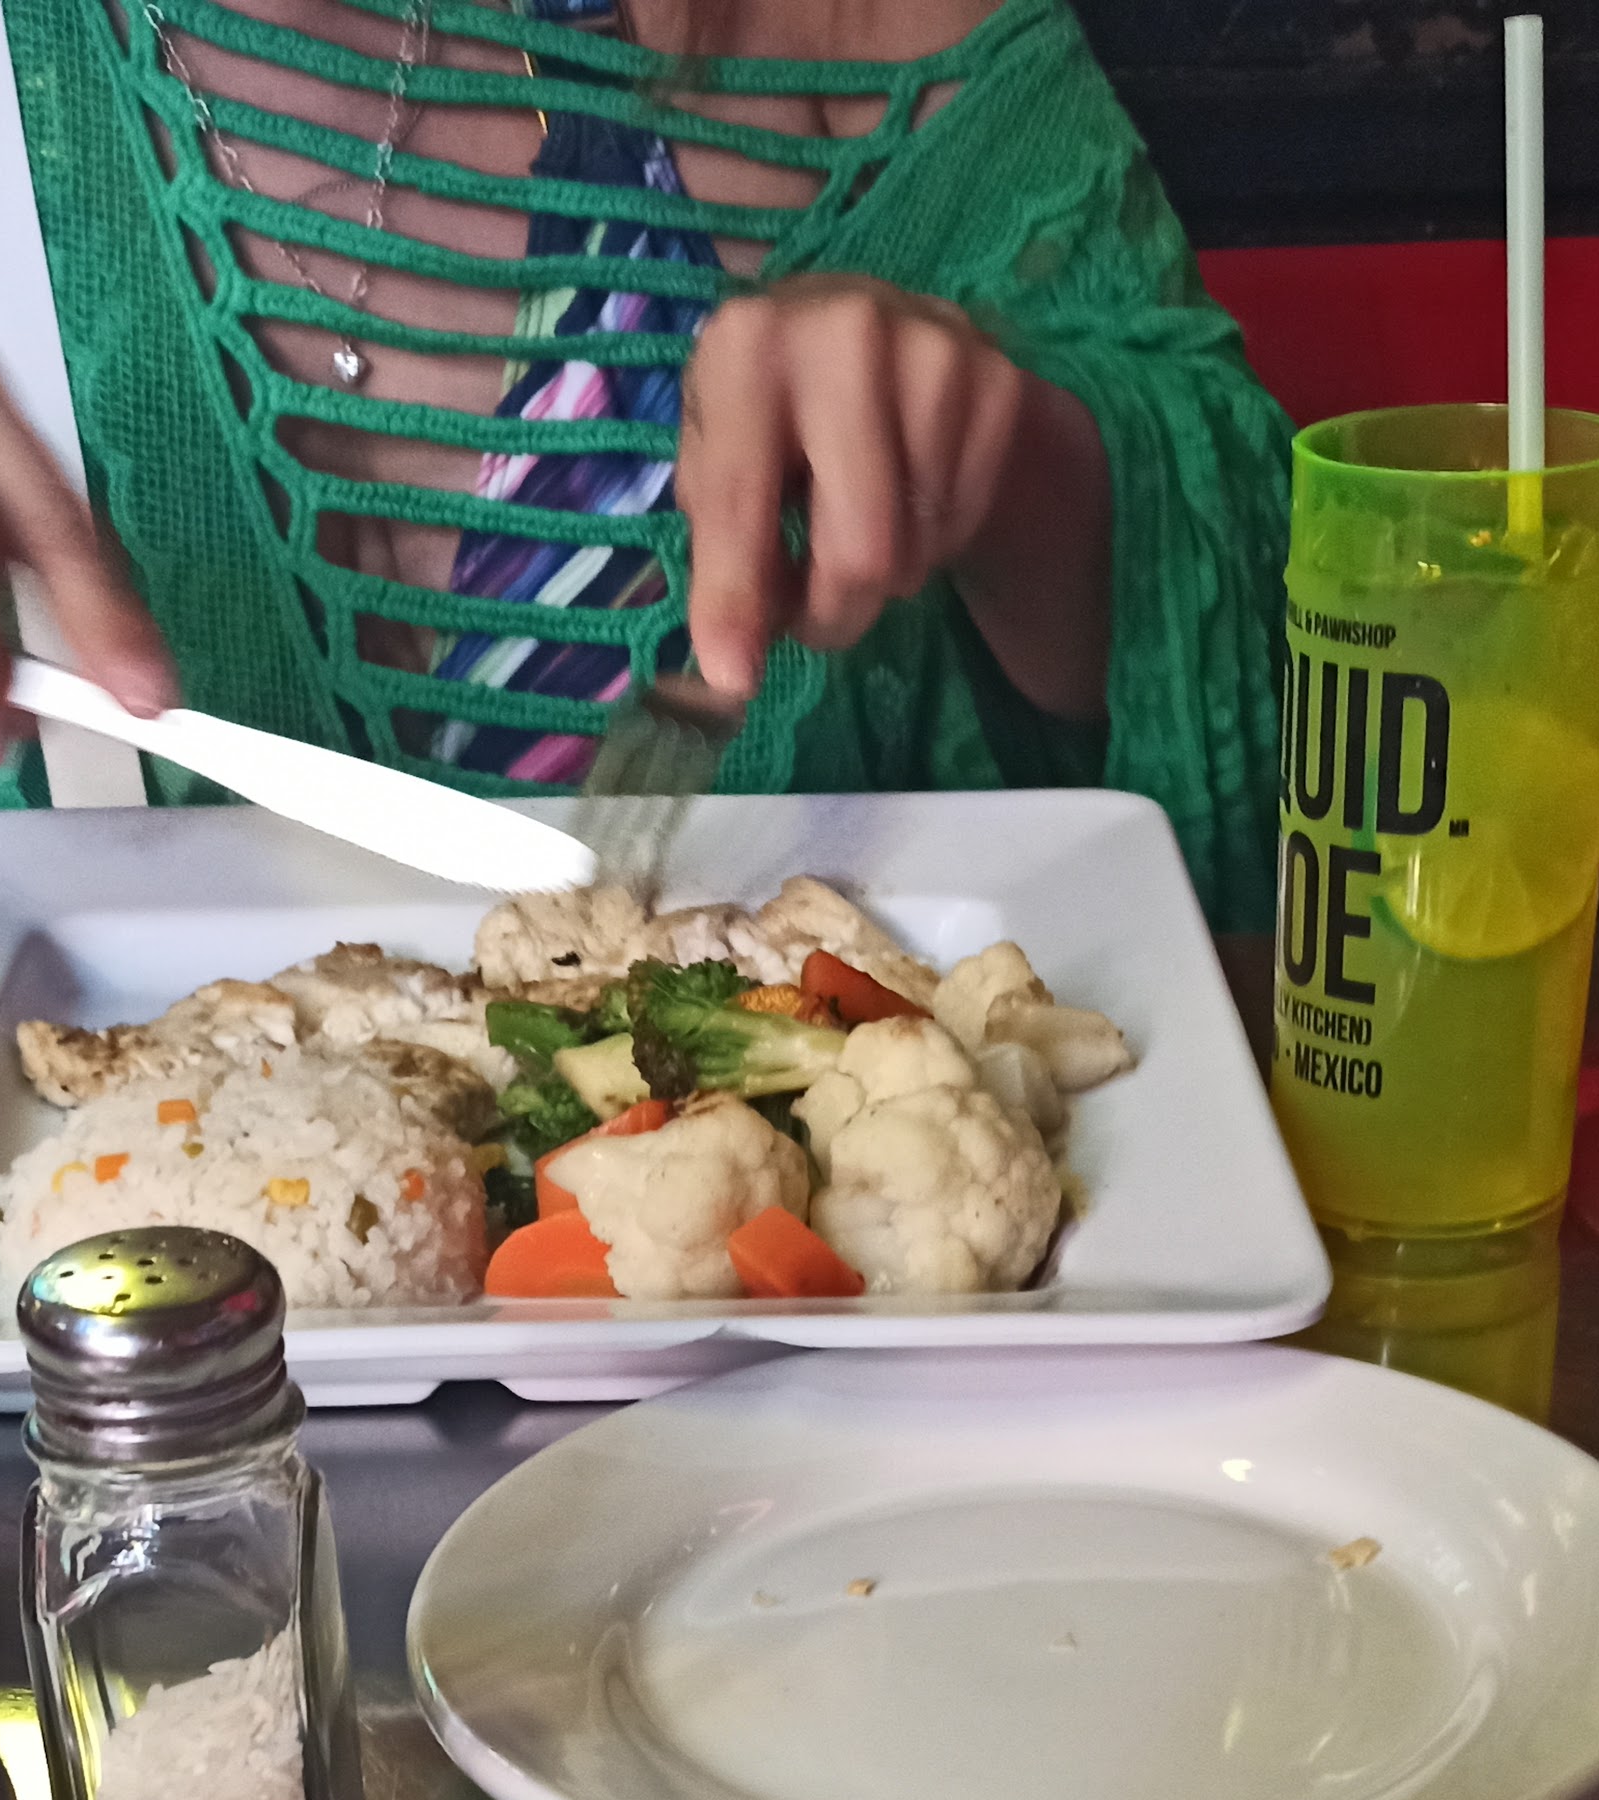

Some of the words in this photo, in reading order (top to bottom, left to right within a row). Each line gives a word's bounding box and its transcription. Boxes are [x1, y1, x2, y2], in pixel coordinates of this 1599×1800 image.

[1314, 611, 1397, 649] PAWNSHOP
[1291, 997, 1373, 1047] KITCHEN)
[1294, 1041, 1383, 1099] MEXICO
